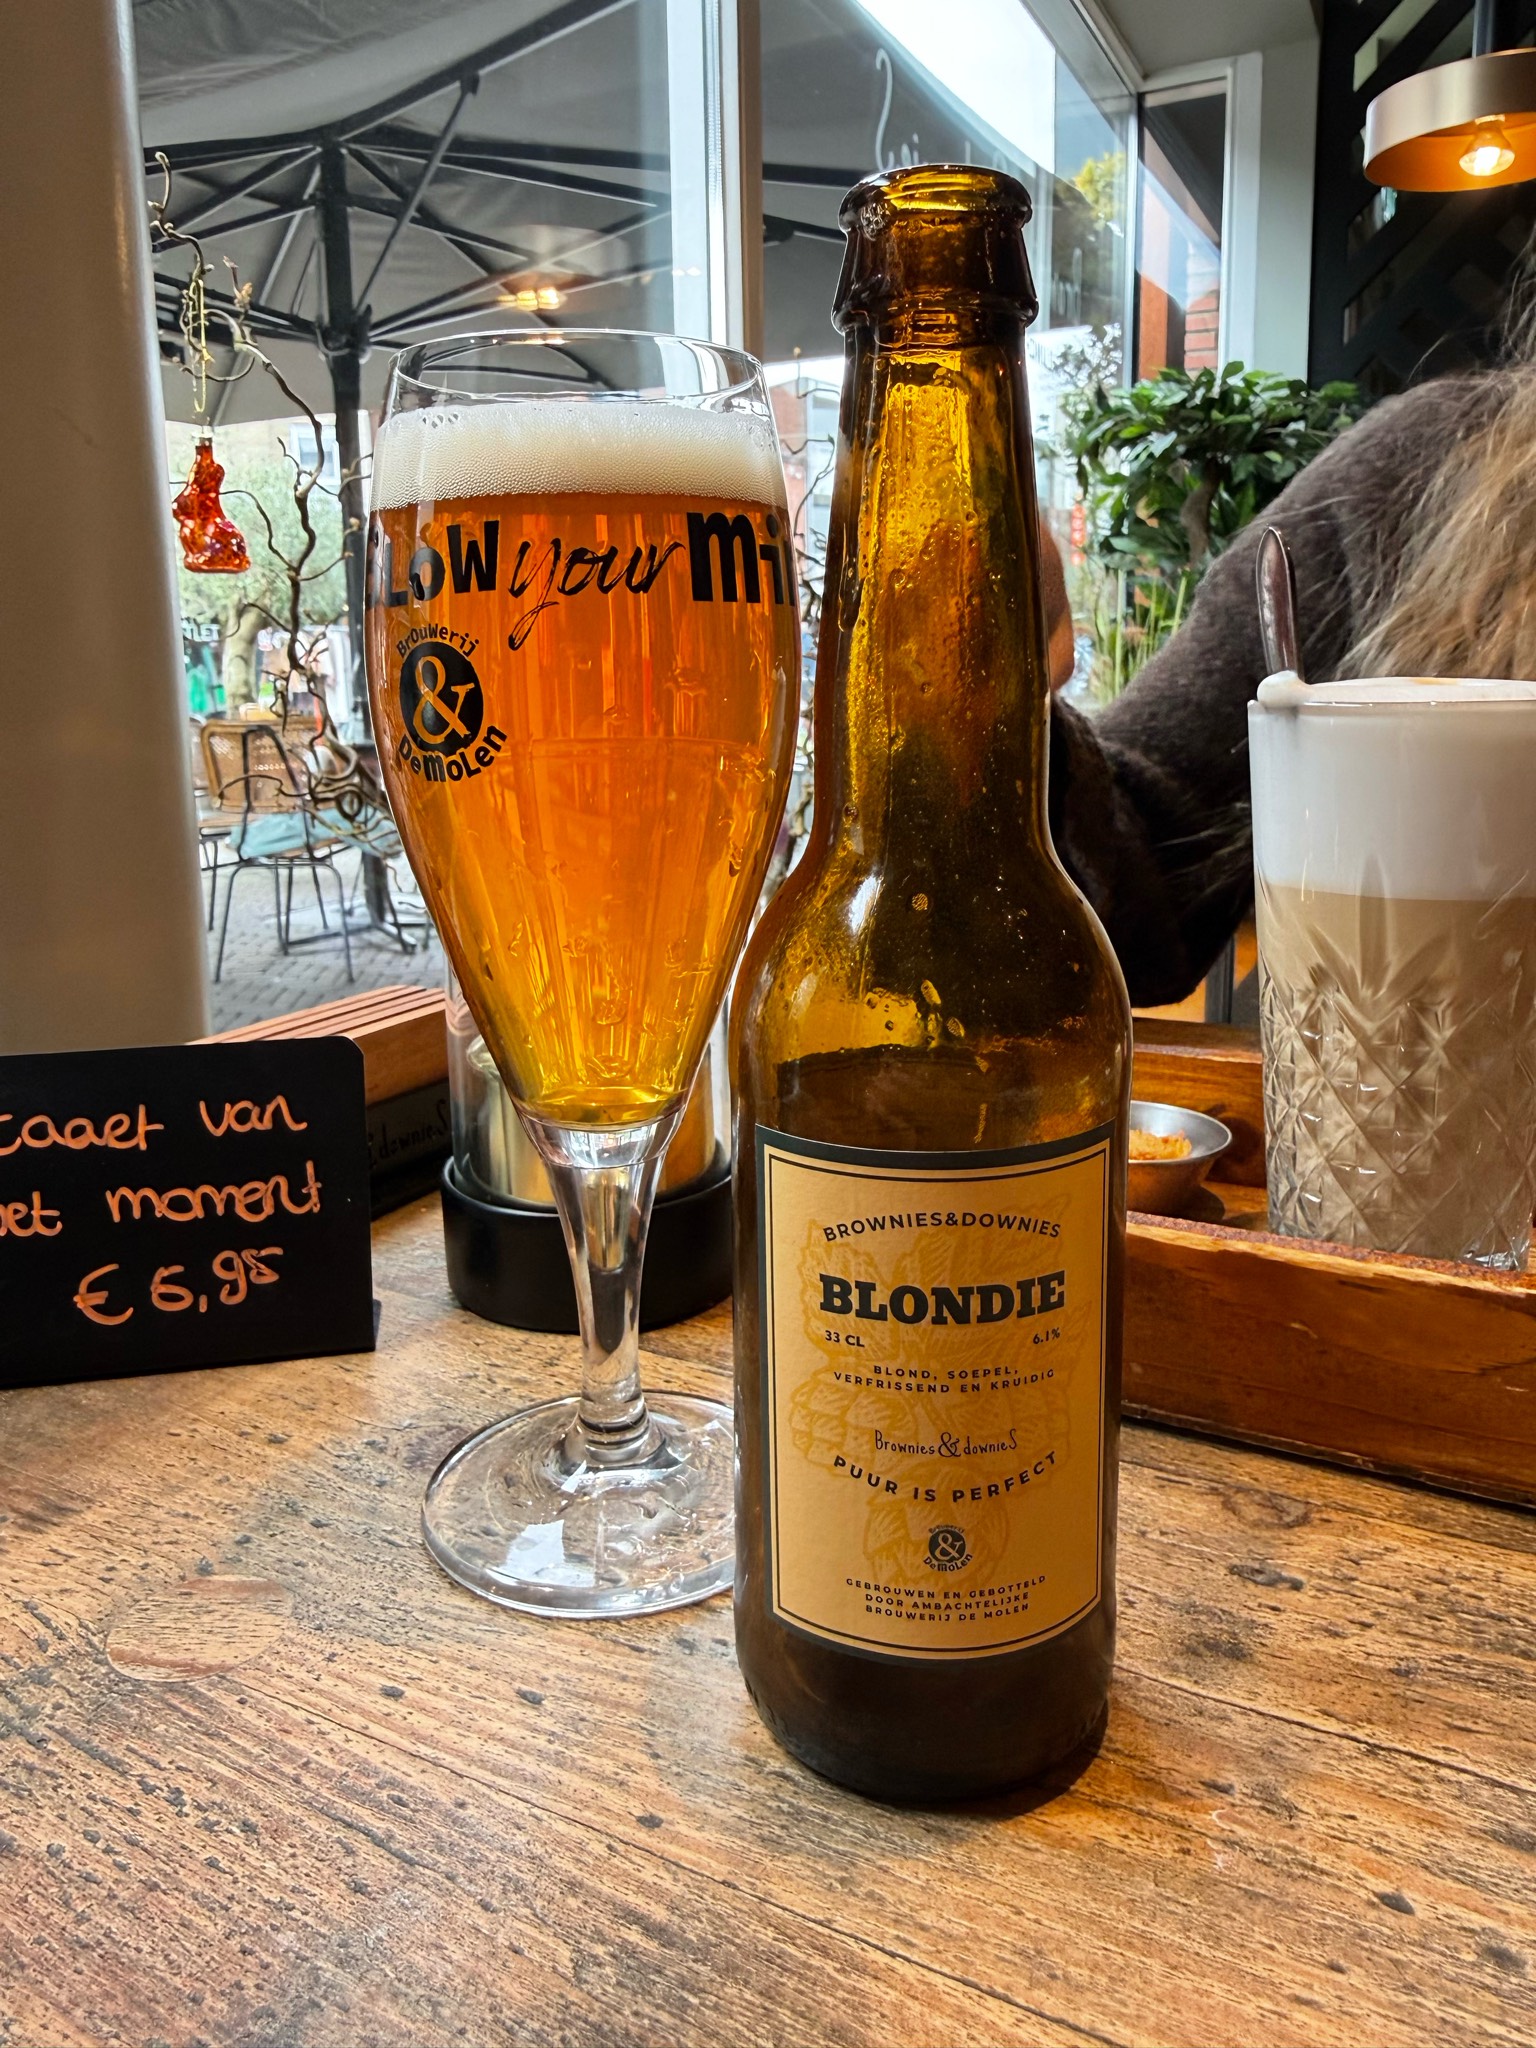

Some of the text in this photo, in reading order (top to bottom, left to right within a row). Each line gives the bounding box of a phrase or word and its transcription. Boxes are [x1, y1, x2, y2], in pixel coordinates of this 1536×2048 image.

[507, 537, 686, 651] your
[199, 1094, 308, 1137] van
[105, 1159, 323, 1223] moment
[823, 1212, 1062, 1242] BROWNIES&DOWNIES
[72, 1246, 284, 1326] € 6,95
[819, 1270, 1065, 1325] BLONDIE
[825, 1329, 865, 1348] 33 CL
[1032, 1327, 1061, 1345] 6.1%
[833, 1368, 1055, 1394] VERFRISSEND EN KRUIDIG
[873, 1365, 1018, 1381] BLOND, SOEPEL,
[833, 1451, 1056, 1503] PUUR IS PERFECT
[845, 1575, 1046, 1599] GEBROUWEN EN GEBOTTELD
[865, 1592, 1029, 1611] DOOR AMBACHTELIJKE
[866, 1603, 1029, 1621] BROUWERIJ DE MOLEN
